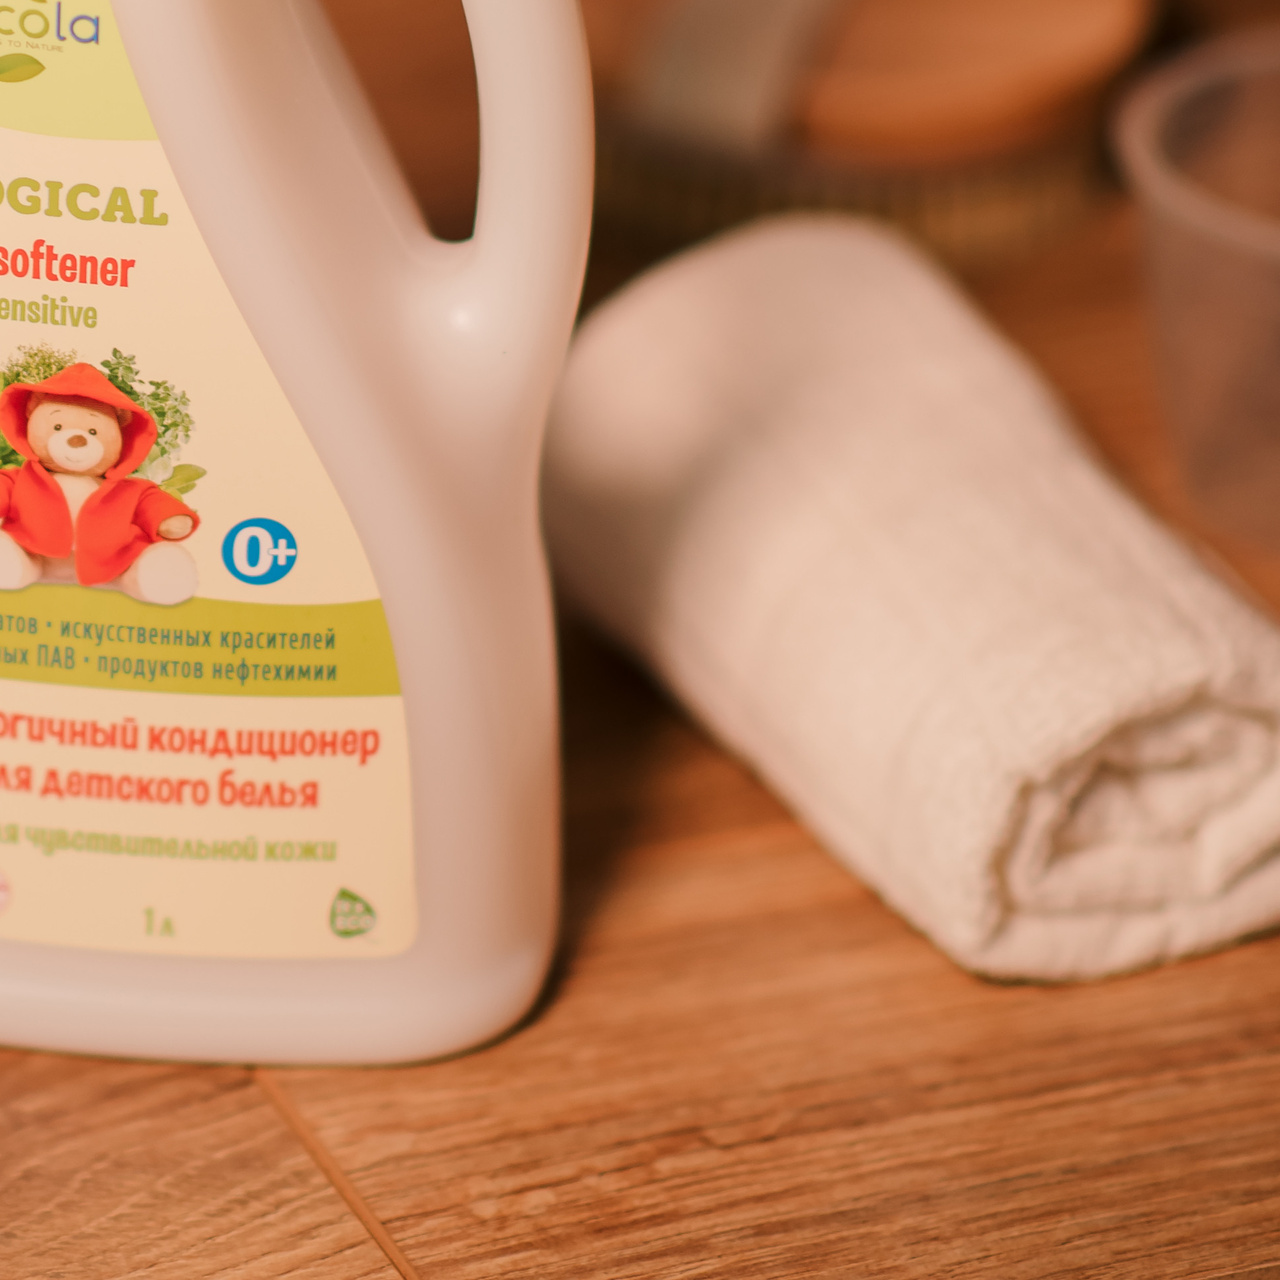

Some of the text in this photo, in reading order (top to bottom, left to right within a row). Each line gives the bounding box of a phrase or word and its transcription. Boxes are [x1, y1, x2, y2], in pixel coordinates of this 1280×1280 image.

[9, 40, 22, 48] TO
[232, 526, 297, 577] 0+
[60, 620, 212, 647] искусственных
[220, 628, 336, 654] красителей
[37, 644, 76, 670] ПАВ
[98, 656, 204, 682] продуктов
[212, 657, 338, 686] нефтехимии
[148, 724, 380, 766] кондиционер
[40, 769, 210, 806] детского
[218, 769, 320, 808] белья
[25, 824, 258, 862] чувствительной
[264, 840, 337, 862] кожи
